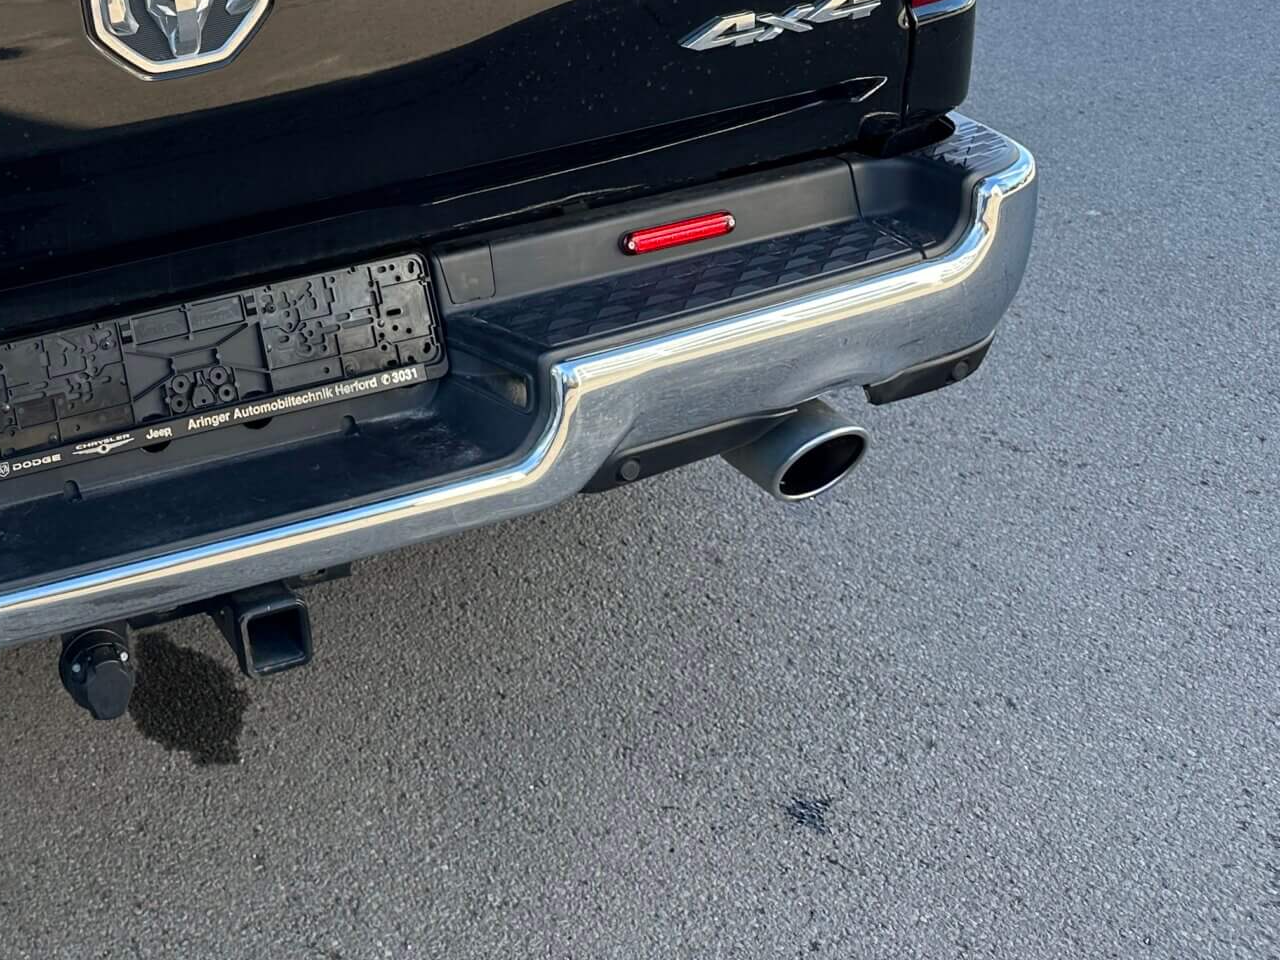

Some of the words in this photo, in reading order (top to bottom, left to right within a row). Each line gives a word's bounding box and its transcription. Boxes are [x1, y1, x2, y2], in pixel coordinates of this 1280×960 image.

[188, 410, 231, 431] Aringer
[233, 386, 333, 420] Automobiltechnik
[335, 377, 377, 397] Herford
[75, 433, 130, 451] CHRYSLER
[145, 427, 173, 441] Jeep
[12, 453, 62, 471] DODGE
